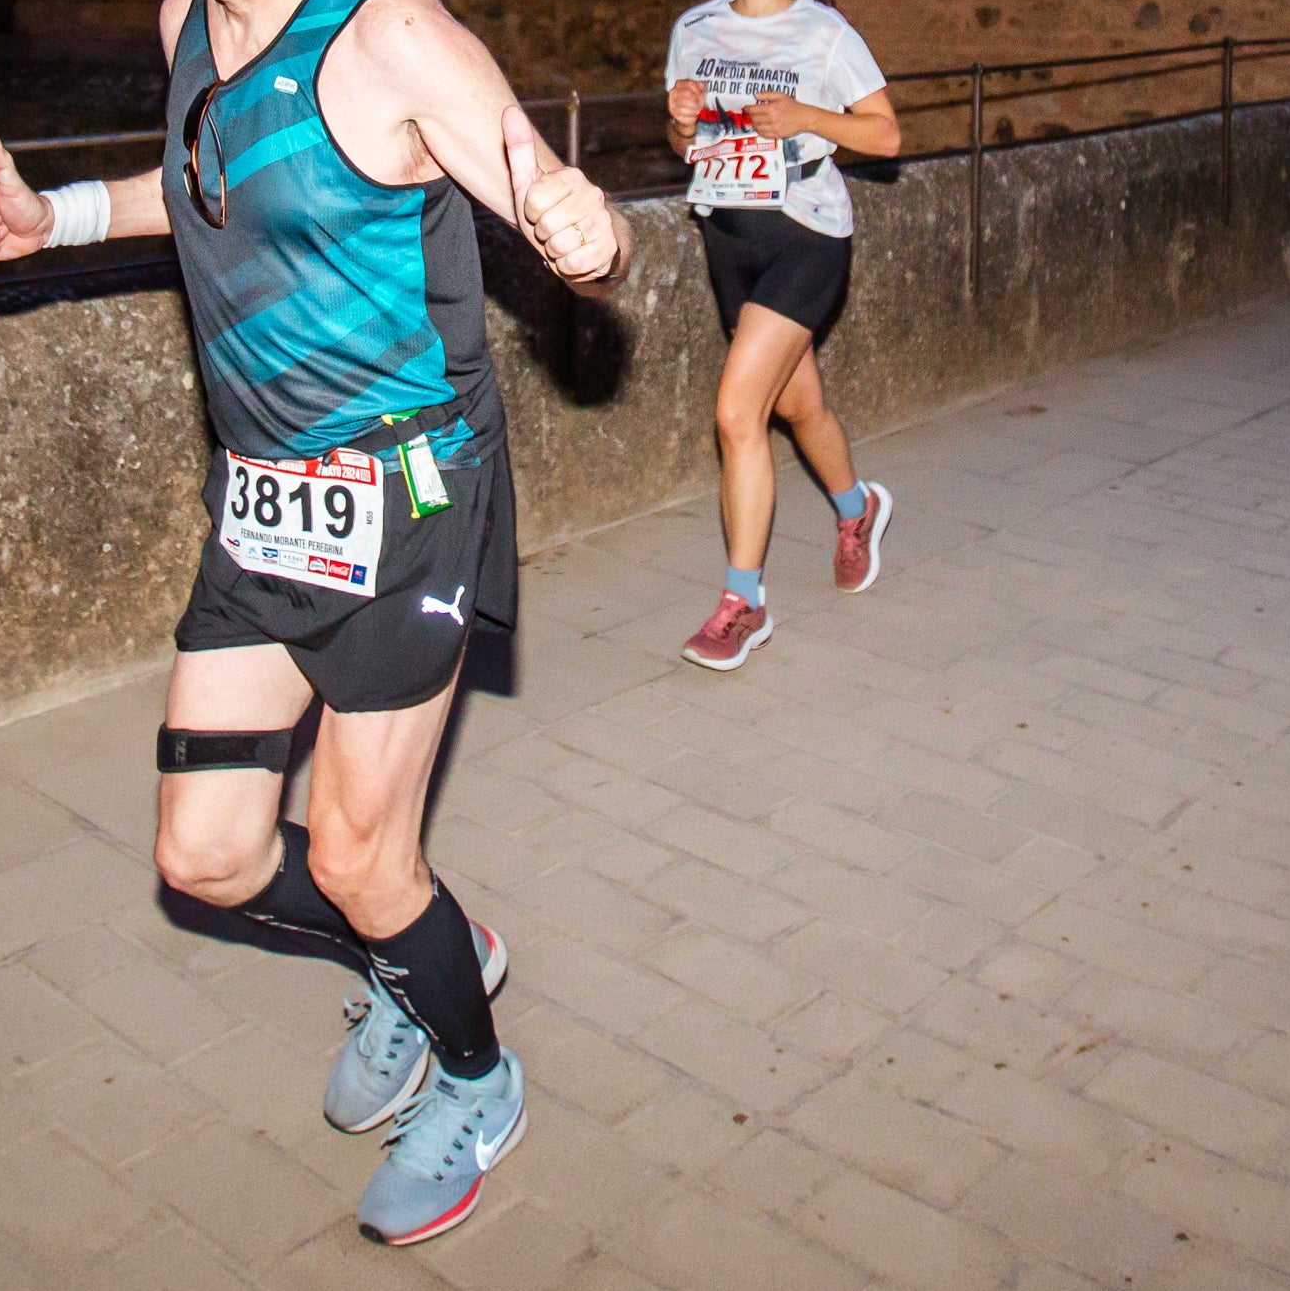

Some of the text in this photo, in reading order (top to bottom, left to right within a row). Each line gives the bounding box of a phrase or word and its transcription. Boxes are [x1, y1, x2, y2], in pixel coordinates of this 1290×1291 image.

[696, 59, 800, 84] 40 MEDIA MARATÓN
[729, 81, 744, 95] DE
[341, 466, 361, 480] 2024
[231, 466, 355, 539] 3819
[241, 527, 343, 556] FERNANDO MORANTE PEREGRINA
